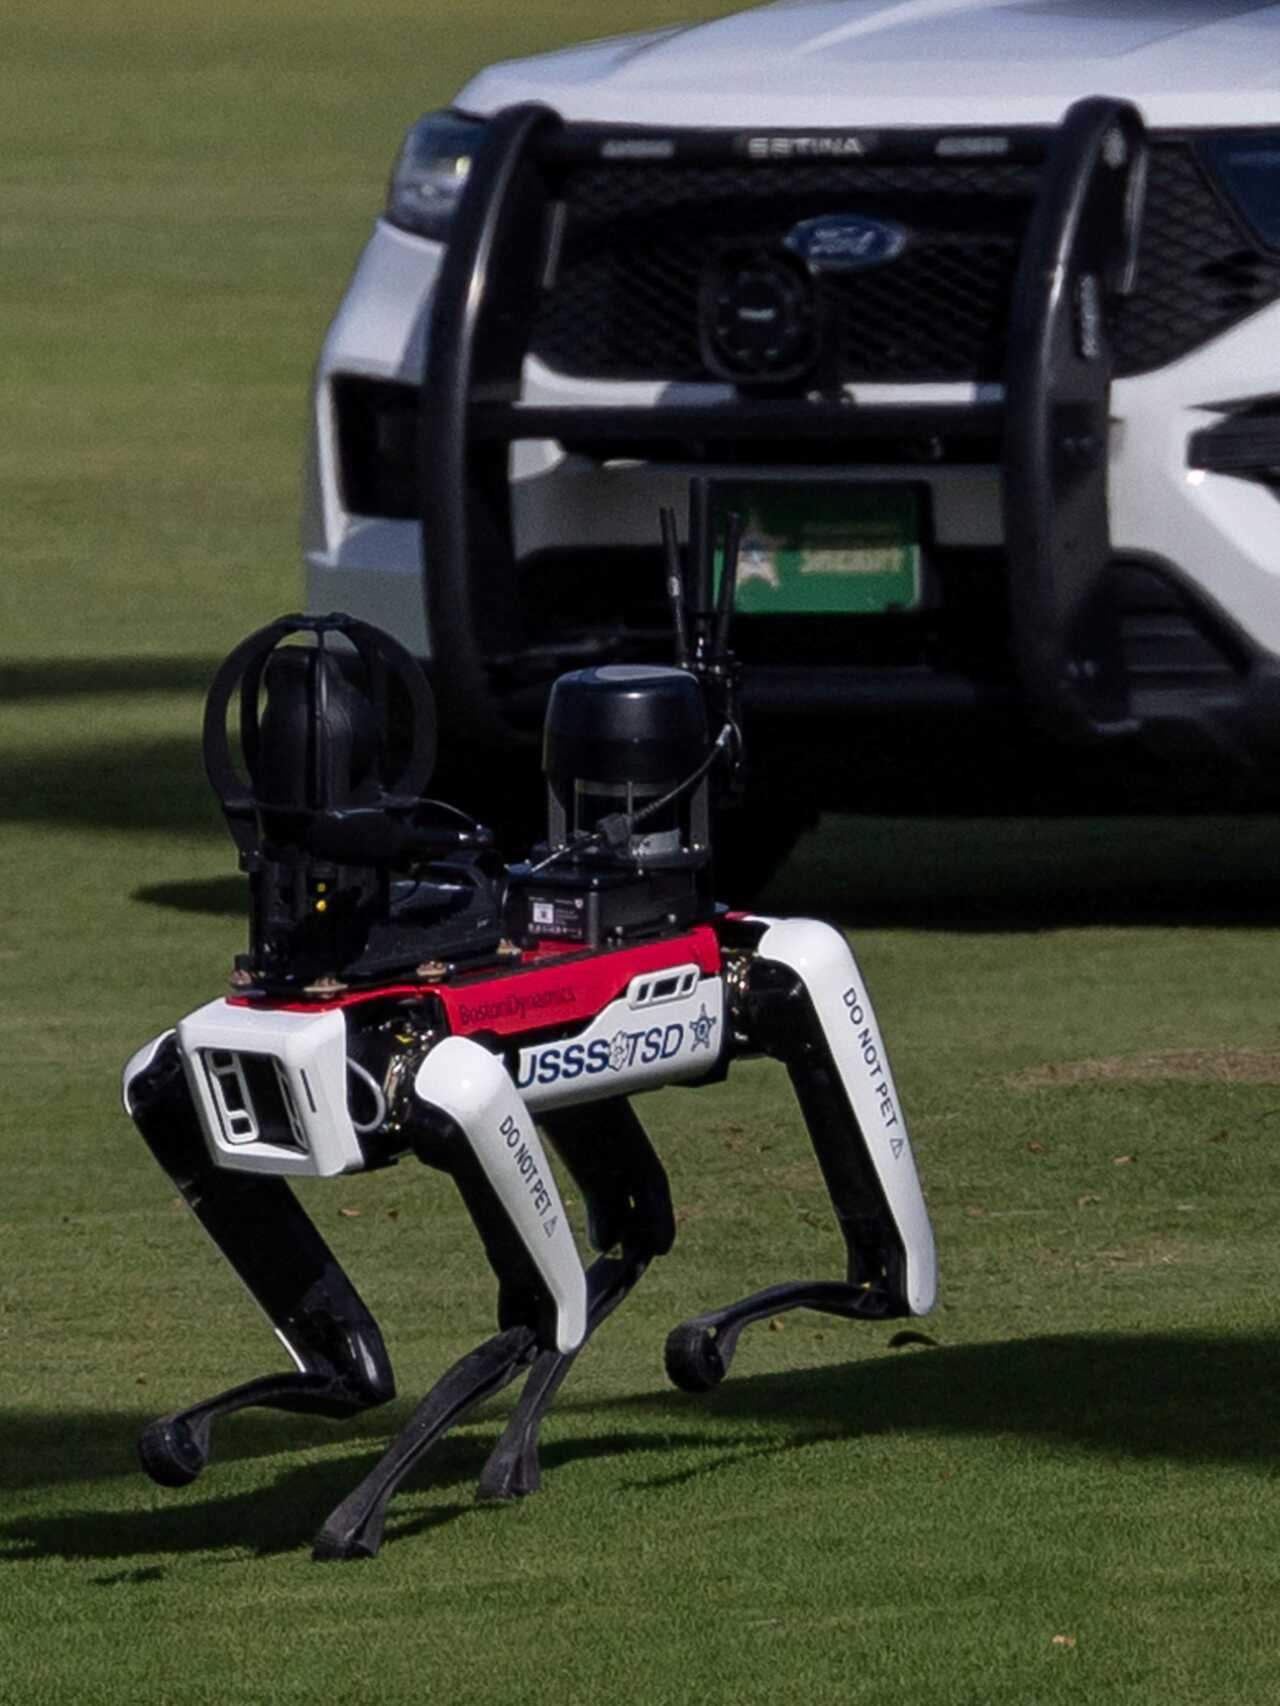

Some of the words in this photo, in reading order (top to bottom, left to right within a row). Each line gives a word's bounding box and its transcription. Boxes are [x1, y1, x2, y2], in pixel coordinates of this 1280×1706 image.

[627, 1024, 684, 1067] TSD
[842, 987, 864, 1025] DO
[857, 1026, 883, 1077] NOT
[875, 1081, 898, 1128] PET
[499, 1115, 520, 1148] DO
[513, 1142, 538, 1184] NOT
[529, 1178, 553, 1216] PET
